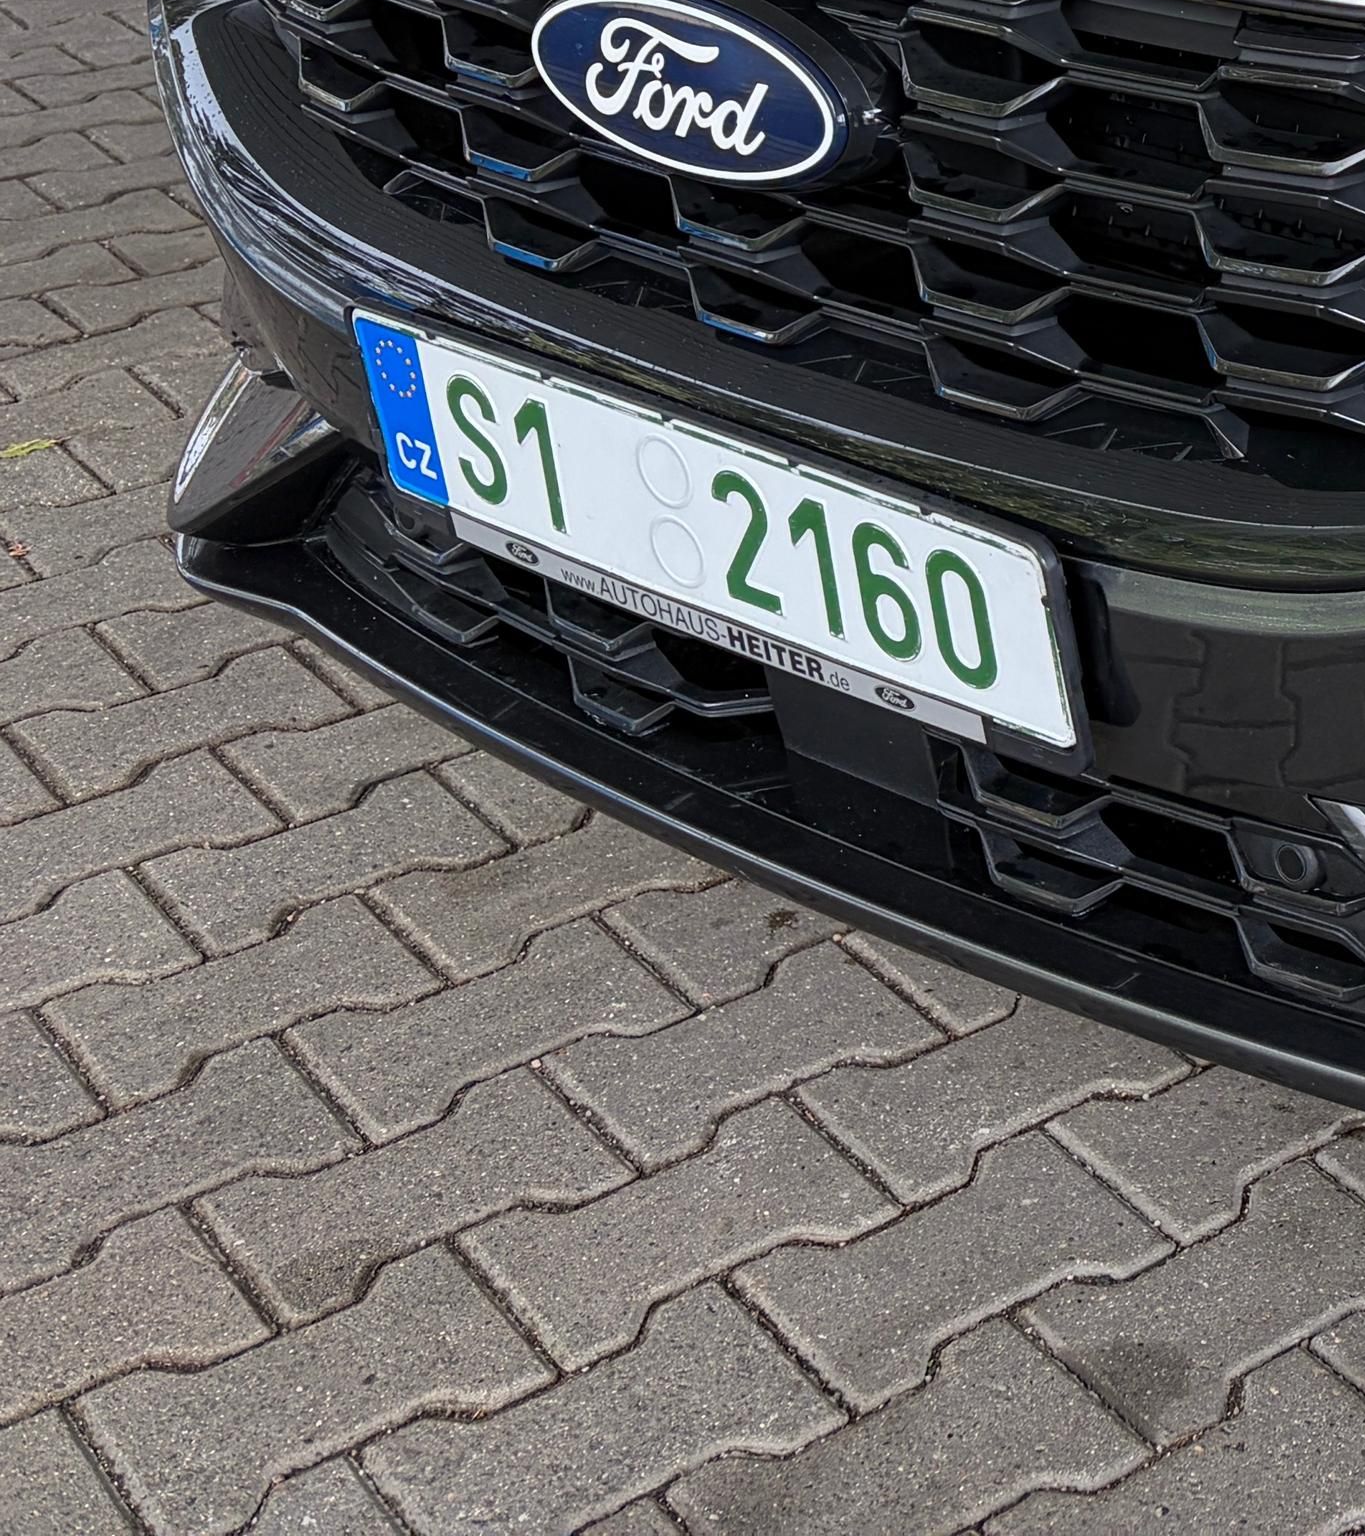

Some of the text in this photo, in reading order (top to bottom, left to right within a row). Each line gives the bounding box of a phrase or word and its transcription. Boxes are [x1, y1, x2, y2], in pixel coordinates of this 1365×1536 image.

[584, 17, 770, 157] Ford
[395, 431, 438, 480] CZ
[445, 373, 998, 690] S1 2160
[509, 542, 537, 565] Ford
[560, 568, 851, 692] www.AUTOHAUS-HEITER.de
[879, 686, 911, 709] Ford
